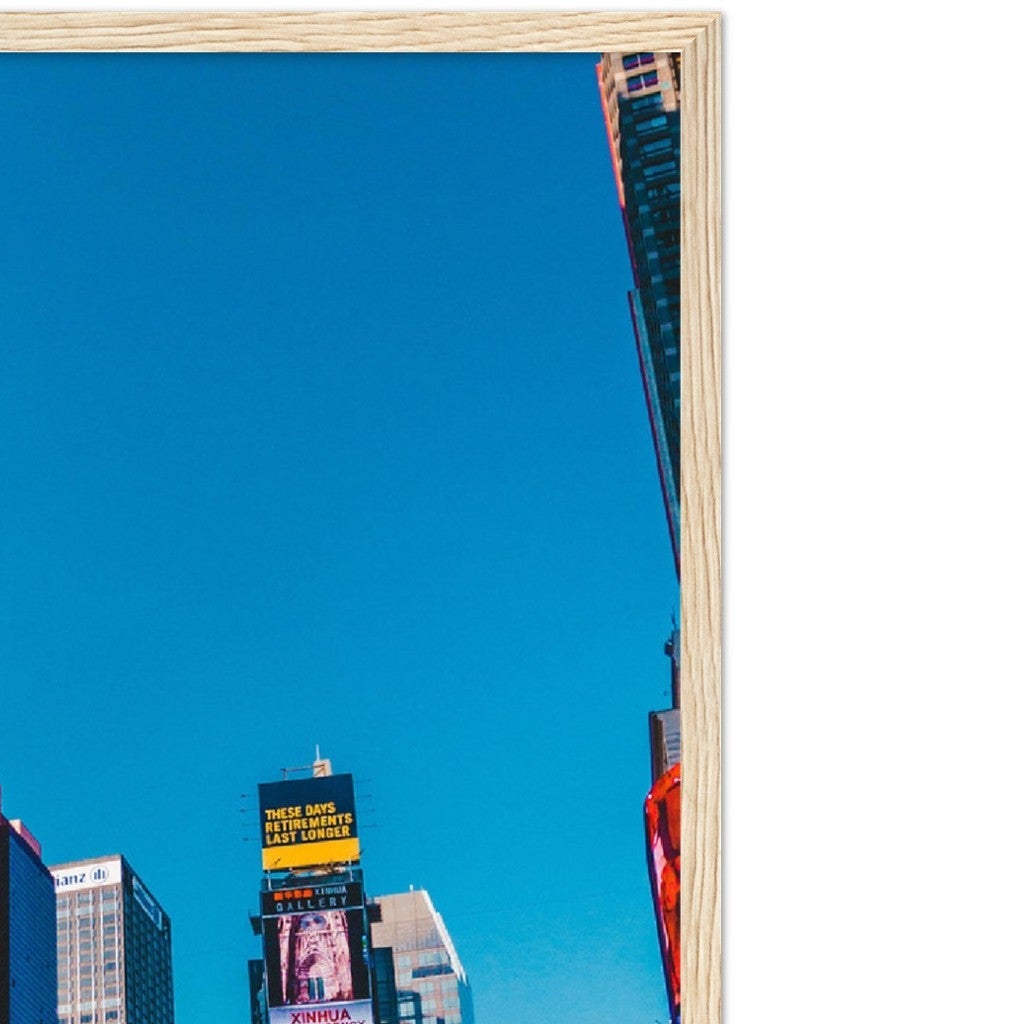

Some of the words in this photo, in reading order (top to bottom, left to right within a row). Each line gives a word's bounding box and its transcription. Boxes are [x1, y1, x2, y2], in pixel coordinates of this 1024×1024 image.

[265, 807, 302, 821] THESE
[305, 802, 336, 817] DAYS
[265, 813, 353, 834] RETIREMENTS
[266, 831, 297, 846] LAST
[301, 825, 351, 843] LONGER
[56, 873, 86, 887] ianz
[315, 886, 347, 896] XINHUA
[276, 896, 347, 912] GALLERY
[290, 1009, 351, 1024] XINHUA
